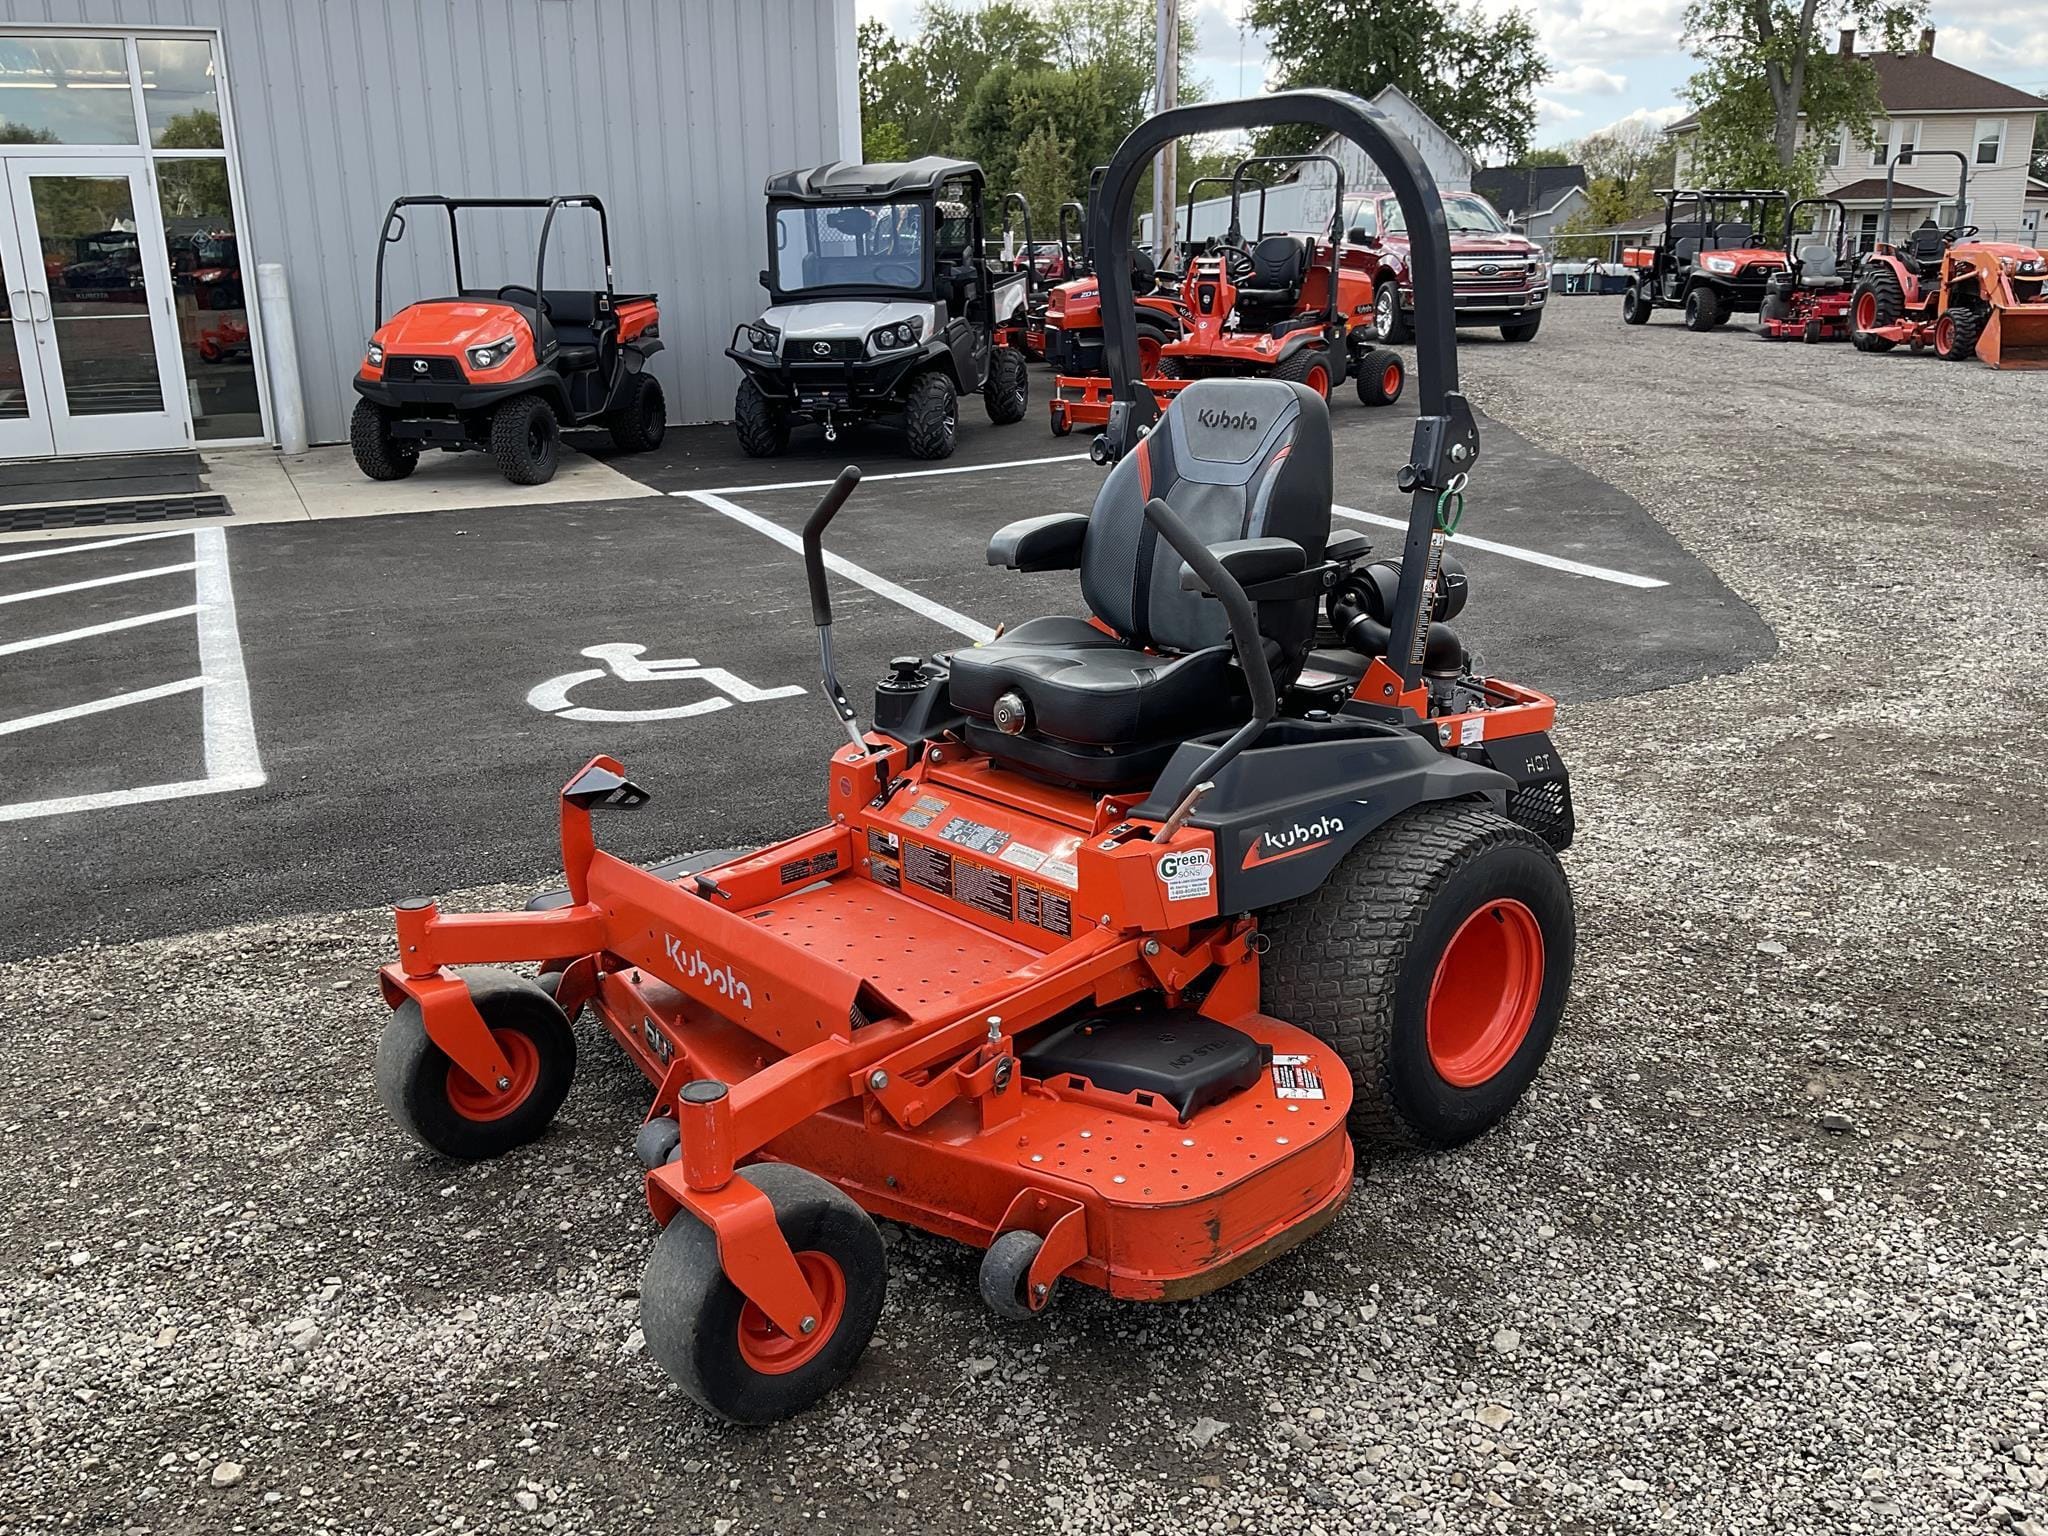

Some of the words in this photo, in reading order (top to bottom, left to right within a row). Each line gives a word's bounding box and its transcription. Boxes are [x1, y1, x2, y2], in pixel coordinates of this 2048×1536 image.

[1198, 409, 1257, 430] Kubota
[1525, 754, 1550, 774] HOT
[1264, 815, 1344, 849] Kubota
[1161, 854, 1205, 878] Green
[1178, 870, 1201, 879] SONS
[665, 933, 752, 1010] Kubota
[1168, 1055, 1195, 1070] NO
